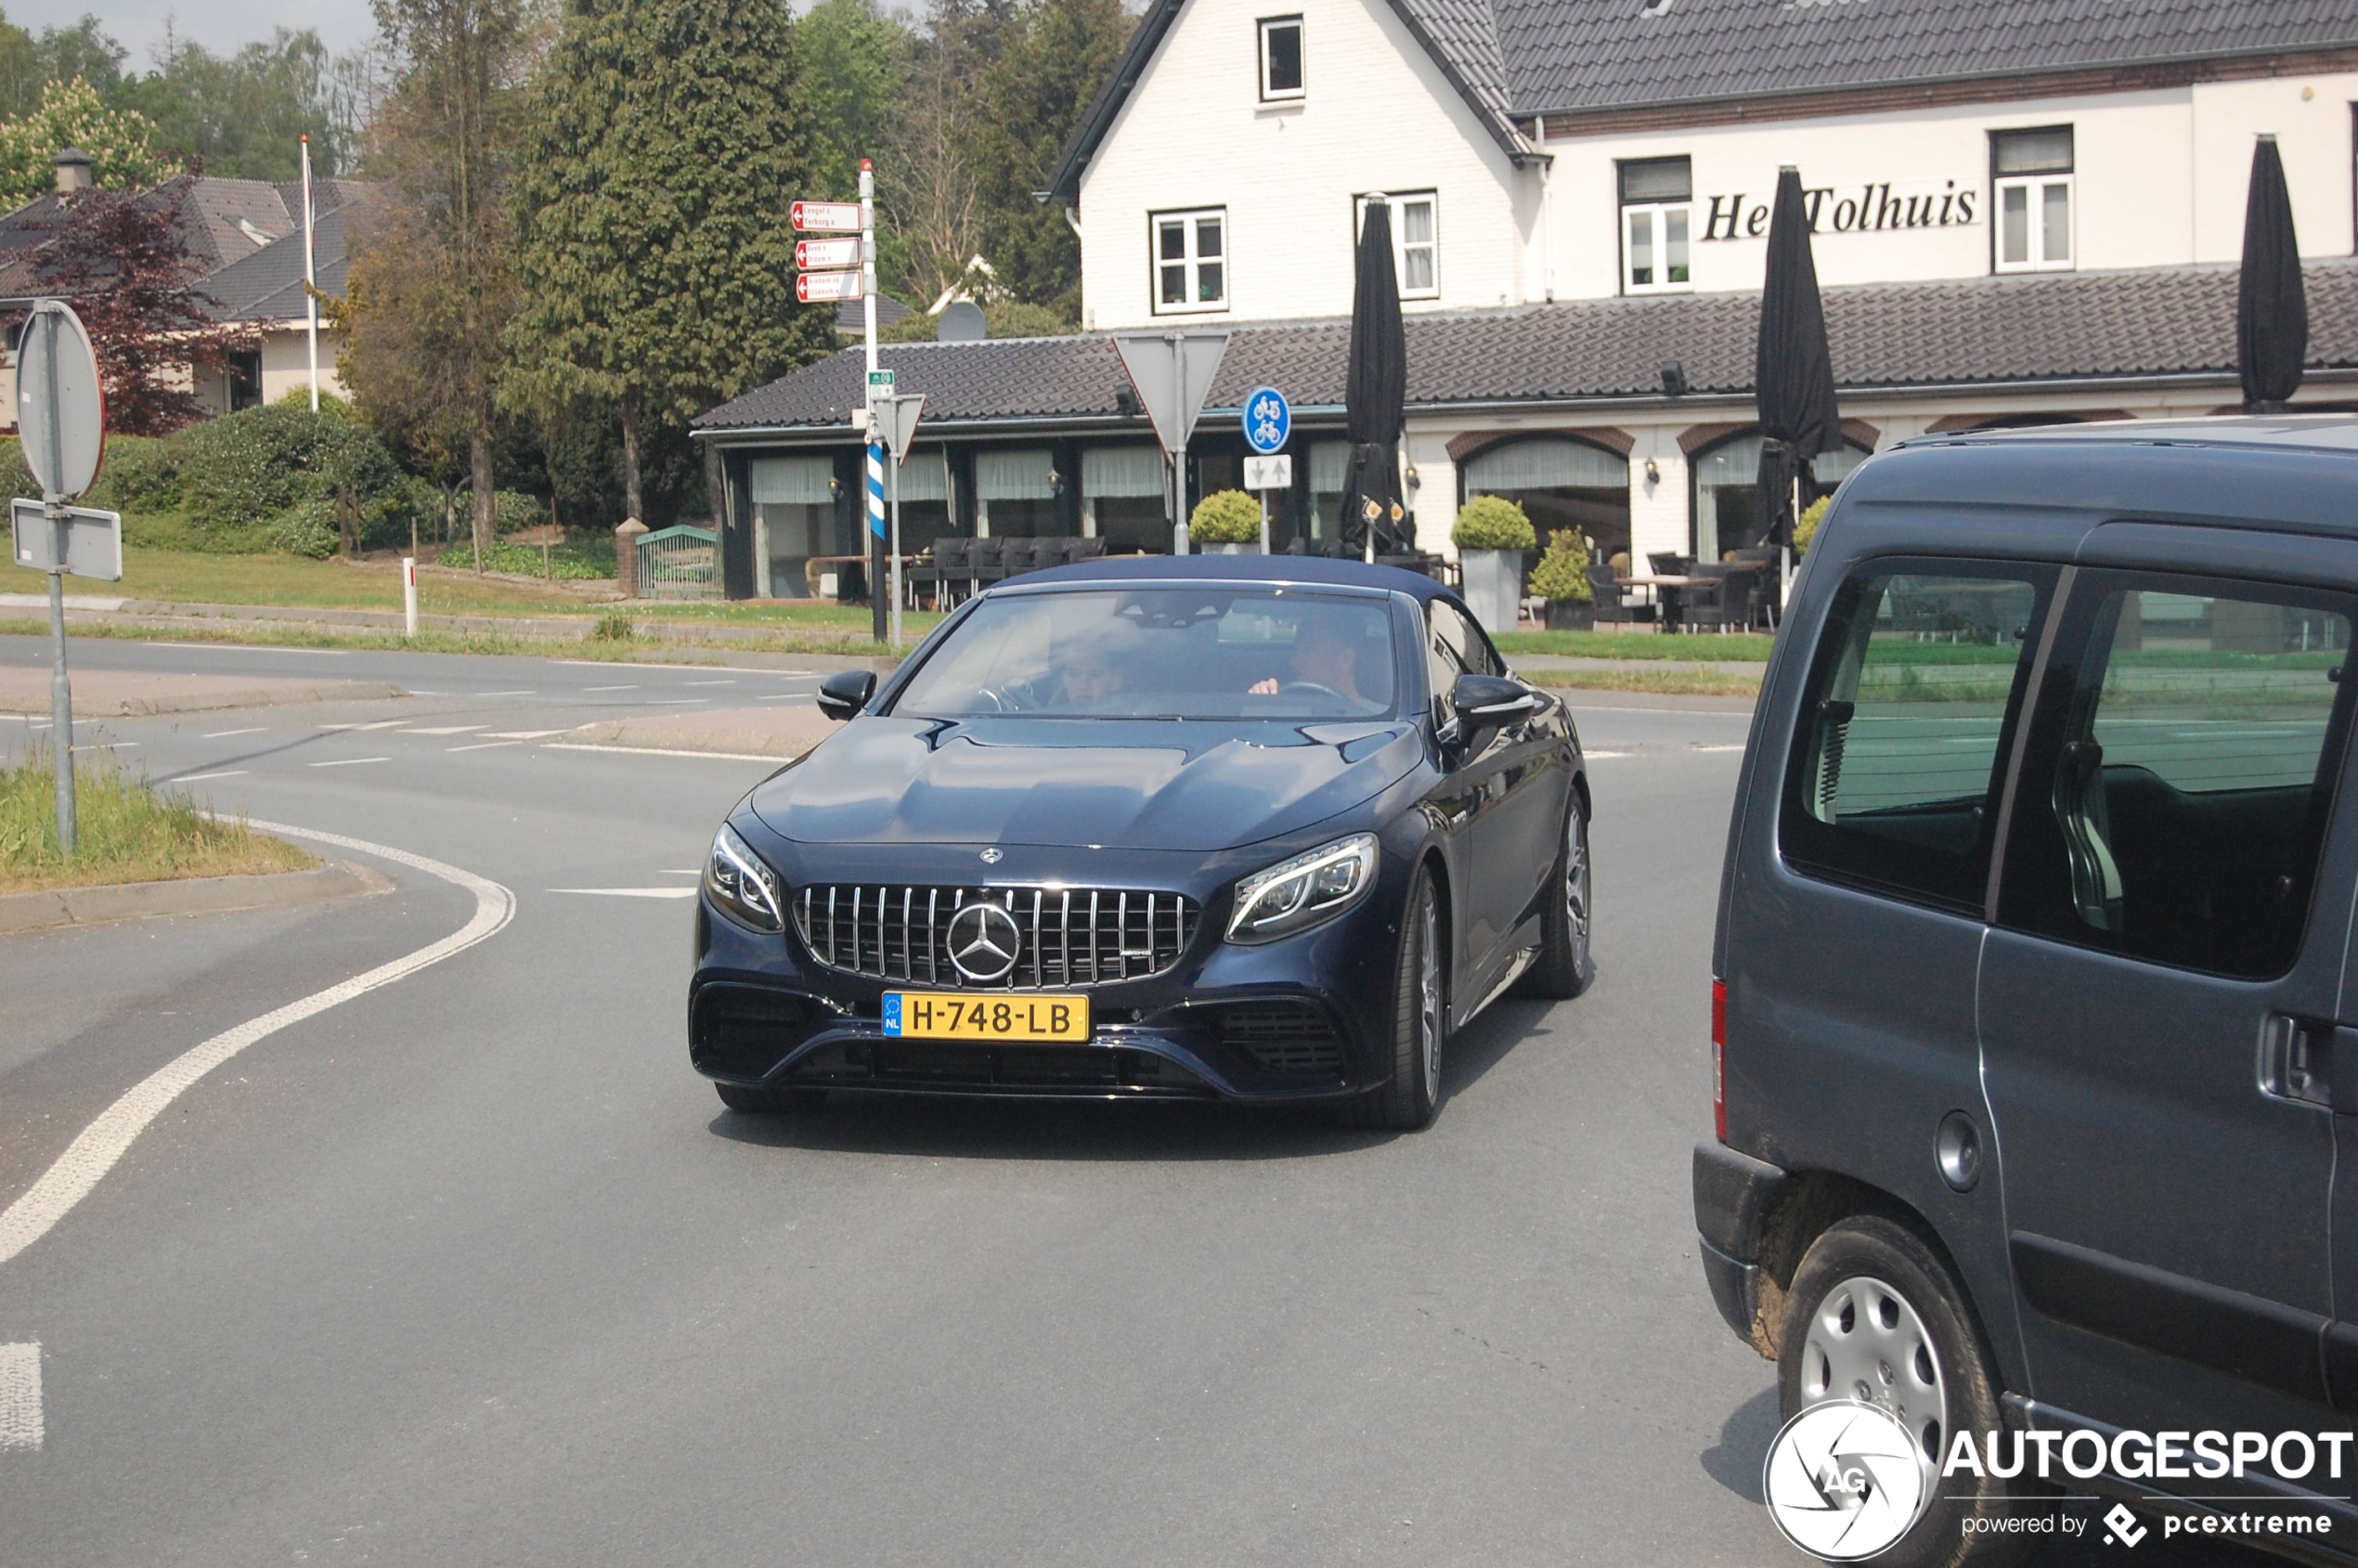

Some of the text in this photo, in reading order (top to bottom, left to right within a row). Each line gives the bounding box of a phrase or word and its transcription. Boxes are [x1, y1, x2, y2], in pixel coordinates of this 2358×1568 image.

[1701, 179, 1976, 242] He Tolhuis
[886, 1018, 900, 1029] NL
[913, 1000, 1070, 1034] H-748-LB
